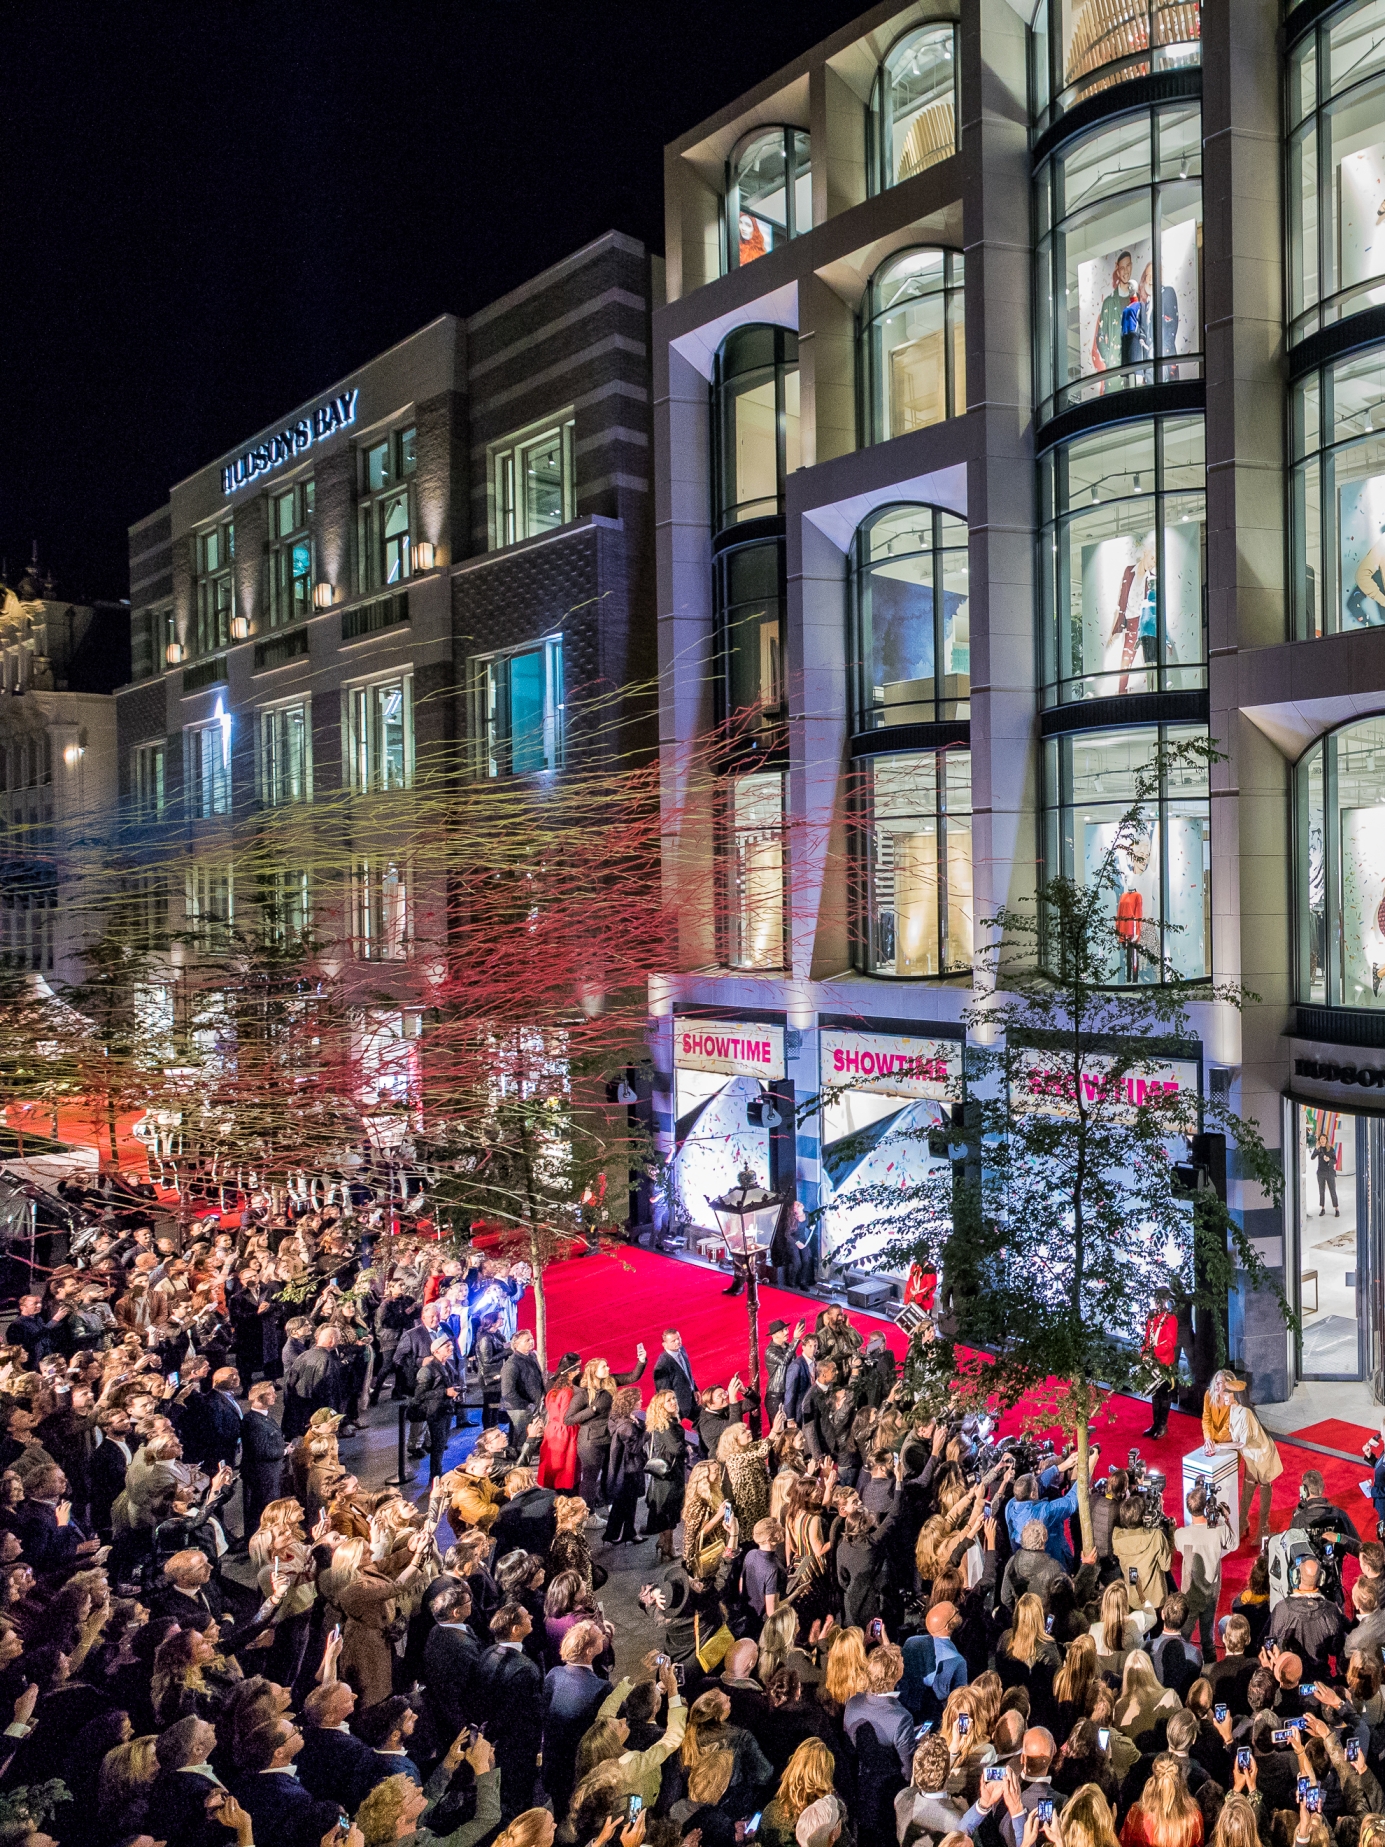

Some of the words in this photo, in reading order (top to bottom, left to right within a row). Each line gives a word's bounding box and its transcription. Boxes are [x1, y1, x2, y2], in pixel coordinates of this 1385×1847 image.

[312, 387, 359, 443] BAY
[683, 1033, 771, 1063] SHOWTIME
[834, 1048, 947, 1083] SHOWTIME
